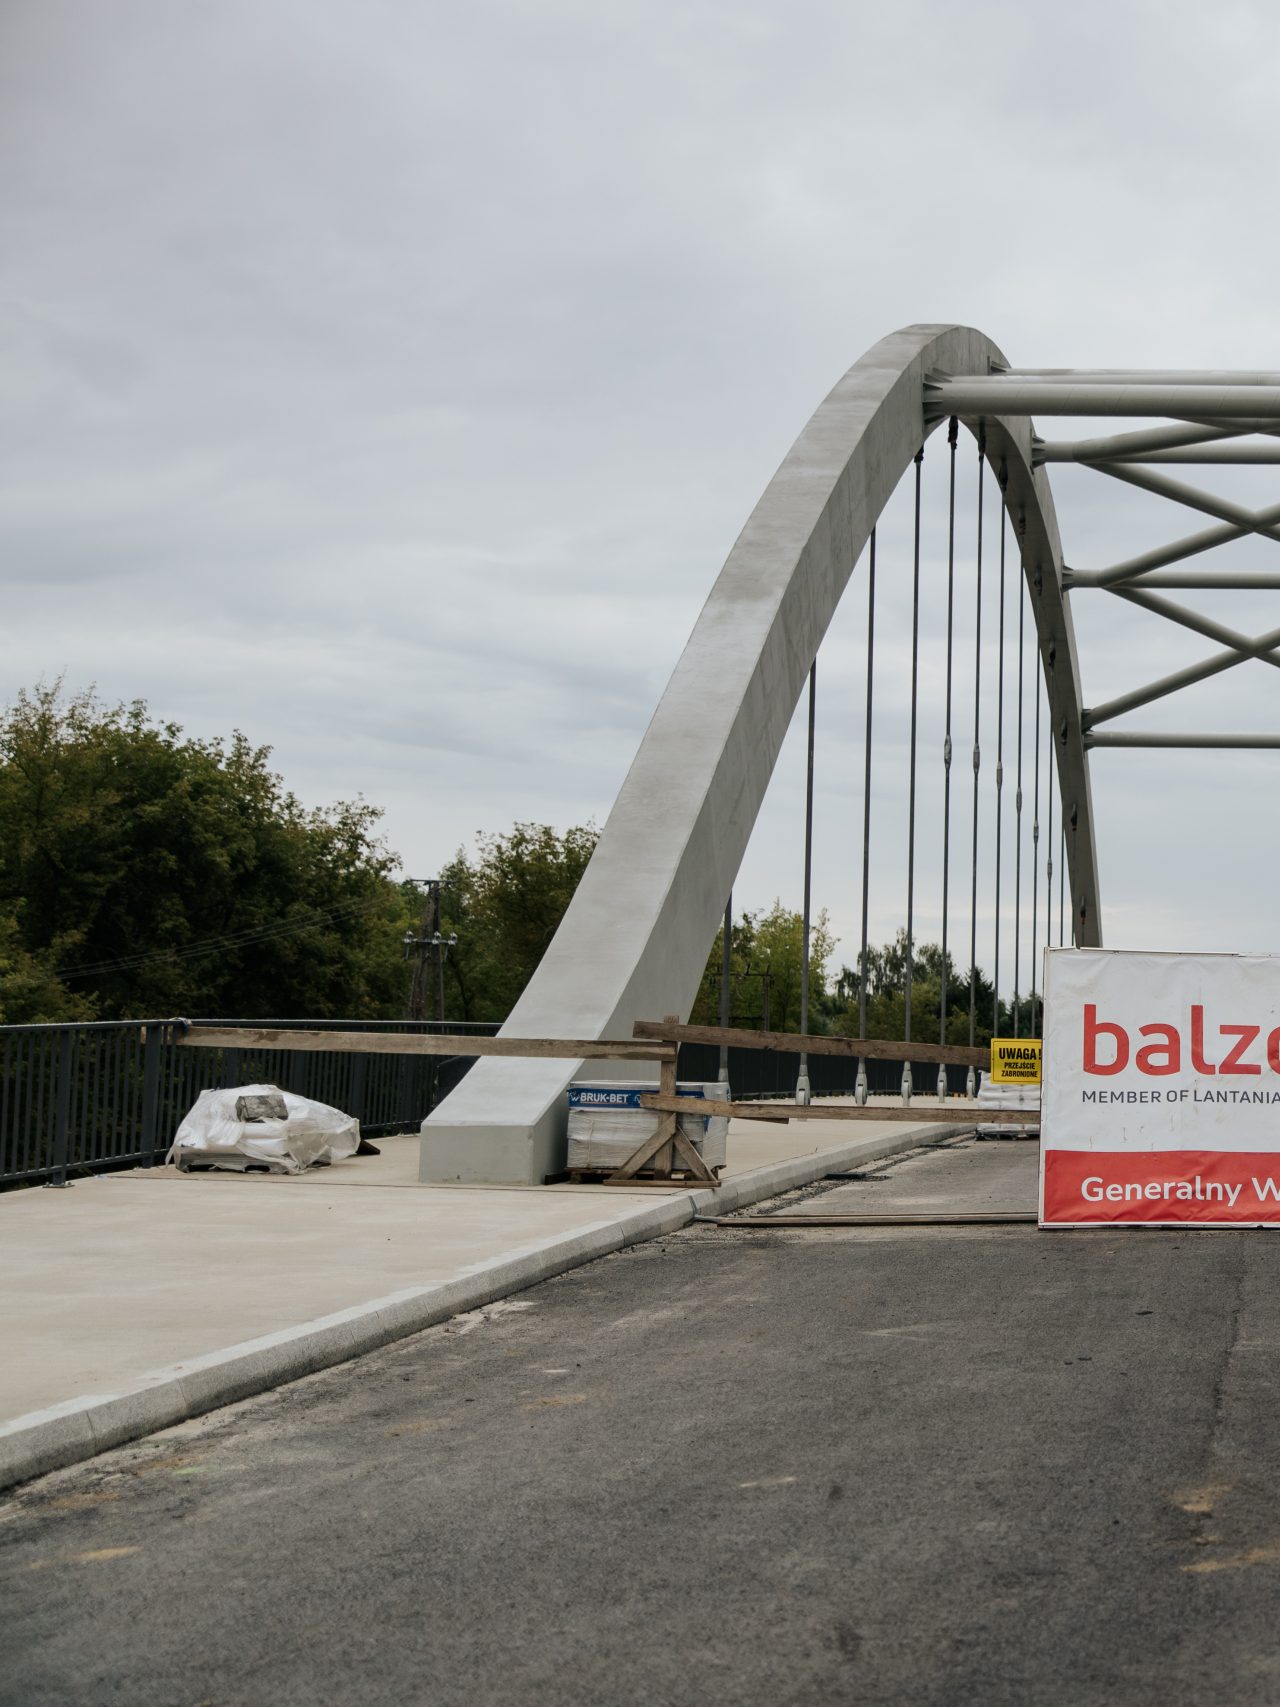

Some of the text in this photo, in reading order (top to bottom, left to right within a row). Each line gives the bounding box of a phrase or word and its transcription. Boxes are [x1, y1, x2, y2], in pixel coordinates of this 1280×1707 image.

[1004, 1062, 1036, 1070] PRZEJŚCIE
[1001, 1070, 1038, 1078] ZABRONIONE
[580, 1092, 629, 1104] BRUK-BET
[1082, 1090, 1162, 1104] MEMBER
[1166, 1089, 1189, 1104] OF
[1081, 1176, 1243, 1207] Generalny
